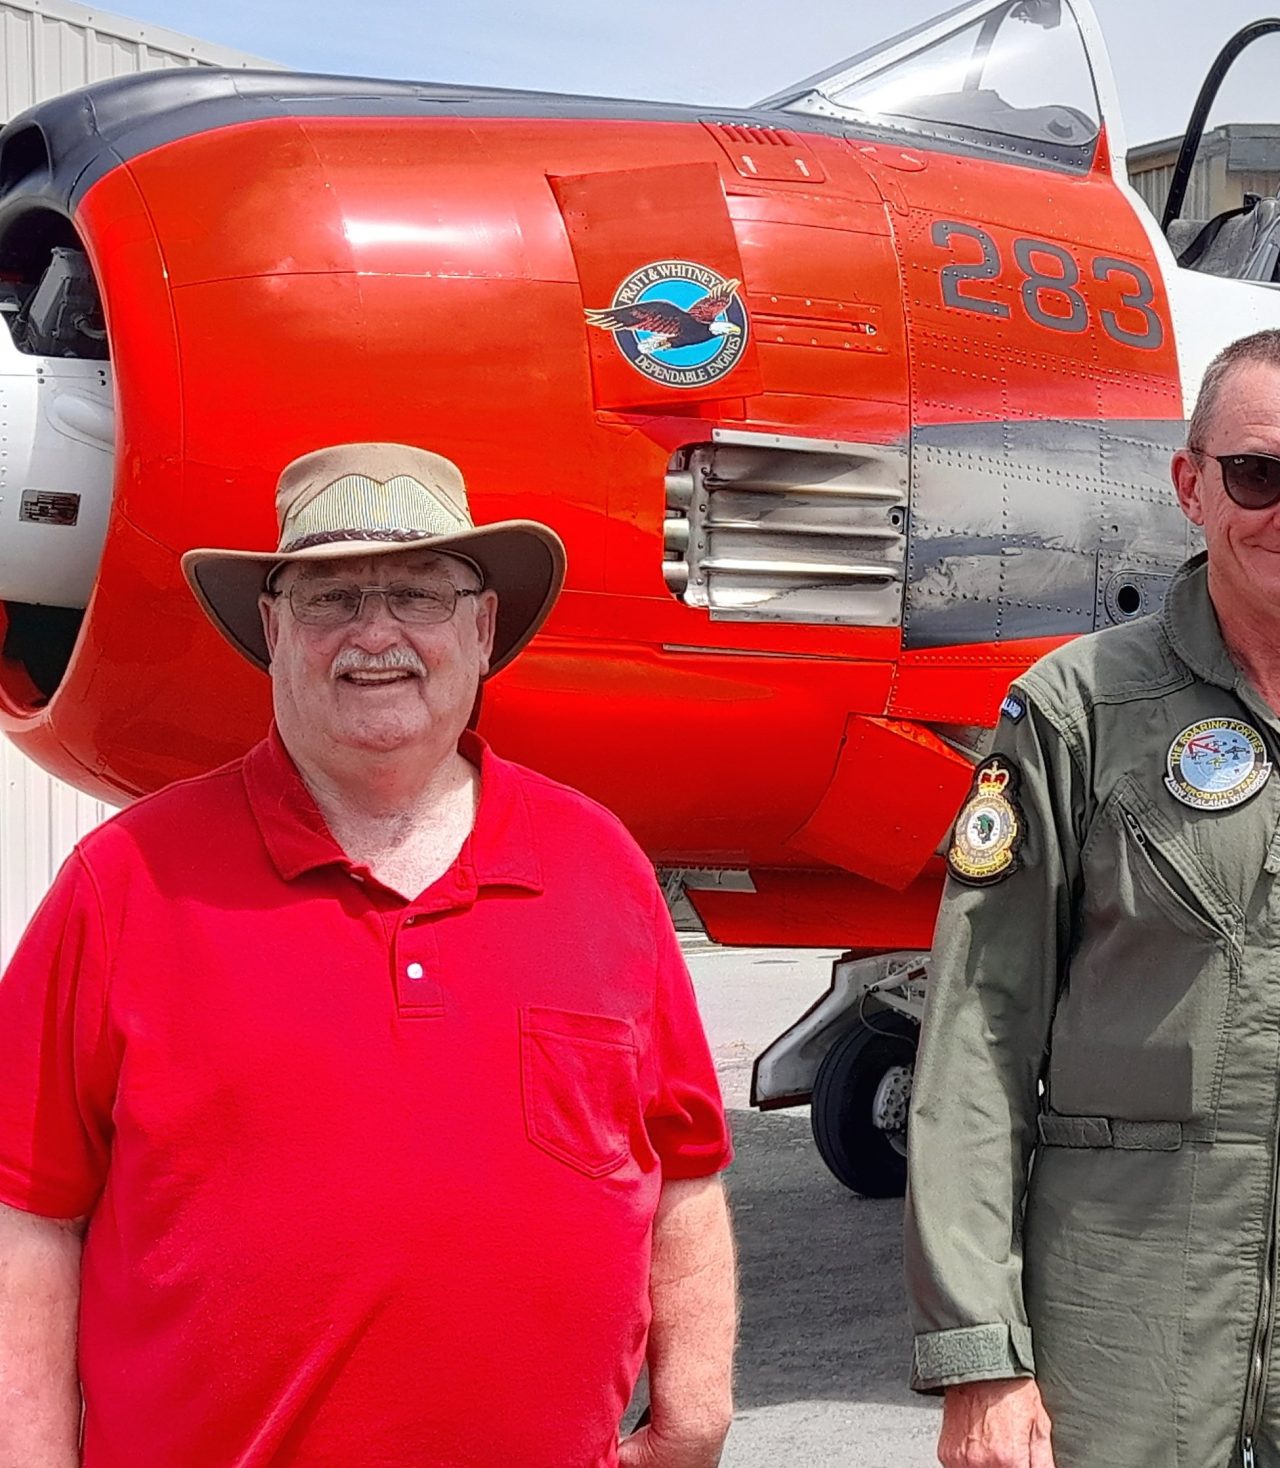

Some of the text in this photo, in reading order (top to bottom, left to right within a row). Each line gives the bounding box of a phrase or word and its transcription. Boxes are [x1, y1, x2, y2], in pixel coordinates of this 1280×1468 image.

[620, 264, 721, 304] PRATT & WHITNEY
[931, 219, 1165, 350] 283
[634, 335, 741, 384] DEPENDABLE ENGINES
[1170, 721, 1265, 766] THE ROARING FORTIES
[1179, 770, 1260, 800] AEROBATIC TEAM
